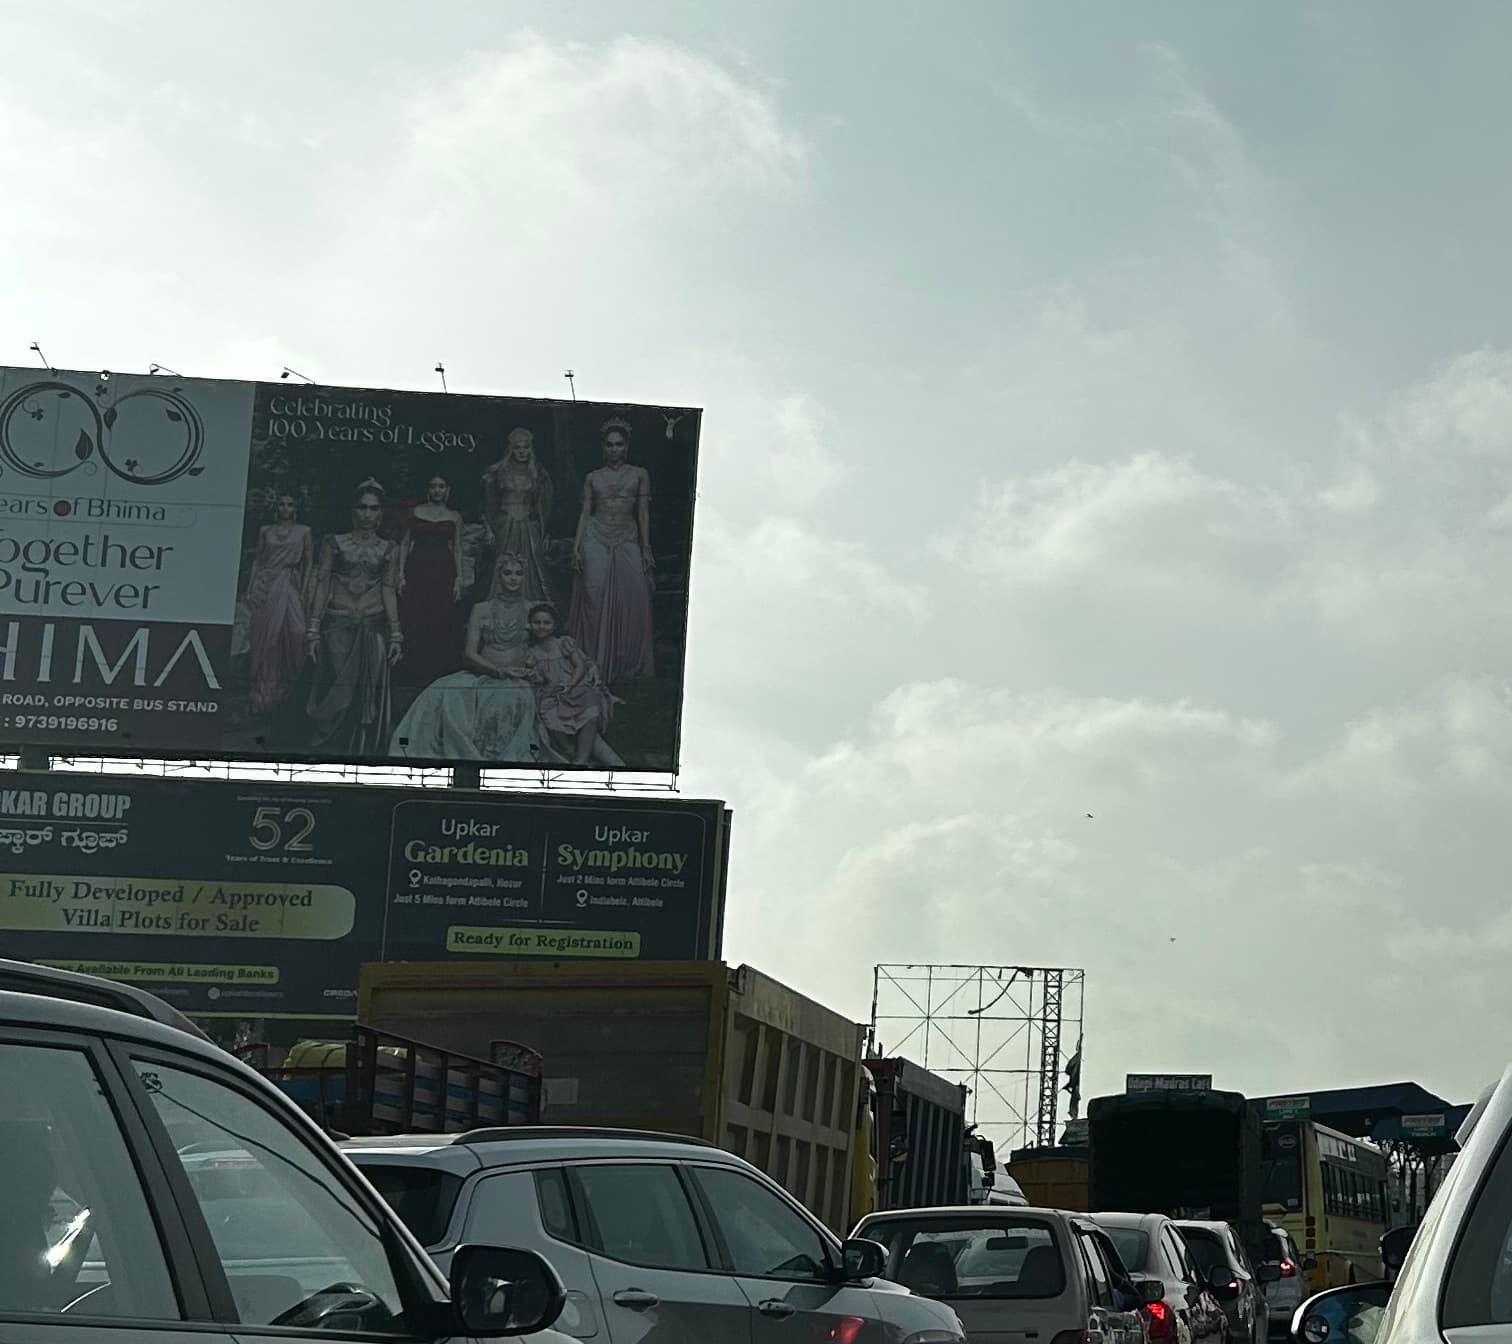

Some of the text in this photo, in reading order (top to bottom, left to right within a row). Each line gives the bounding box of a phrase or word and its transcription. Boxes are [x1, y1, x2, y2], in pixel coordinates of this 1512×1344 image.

[270, 397, 392, 426] Celebrating
[268, 418, 477, 452] 100 Years of Legacy
[88, 498, 165, 520] Bhima
[0, 529, 174, 577] ogether
[2, 694, 218, 713] ROAD, OPPOSITE BUS STAND
[15, 715, 118, 731] 9739196916
[52, 792, 131, 819] GROUP
[248, 807, 315, 851] 52
[441, 818, 501, 840] Upkar
[594, 825, 651, 846] Upkar
[404, 840, 528, 866] Gardenia
[558, 844, 688, 874] Symphony
[9, 880, 64, 902] Fully
[72, 881, 184, 905] Developed
[210, 887, 313, 910] Approved
[62, 908, 260, 931] Villa Plots for Sale
[454, 932, 633, 951] Ready for Registration
[134, 965, 165, 976] From
[187, 966, 234, 979] Leading
[238, 968, 275, 979] Banks
